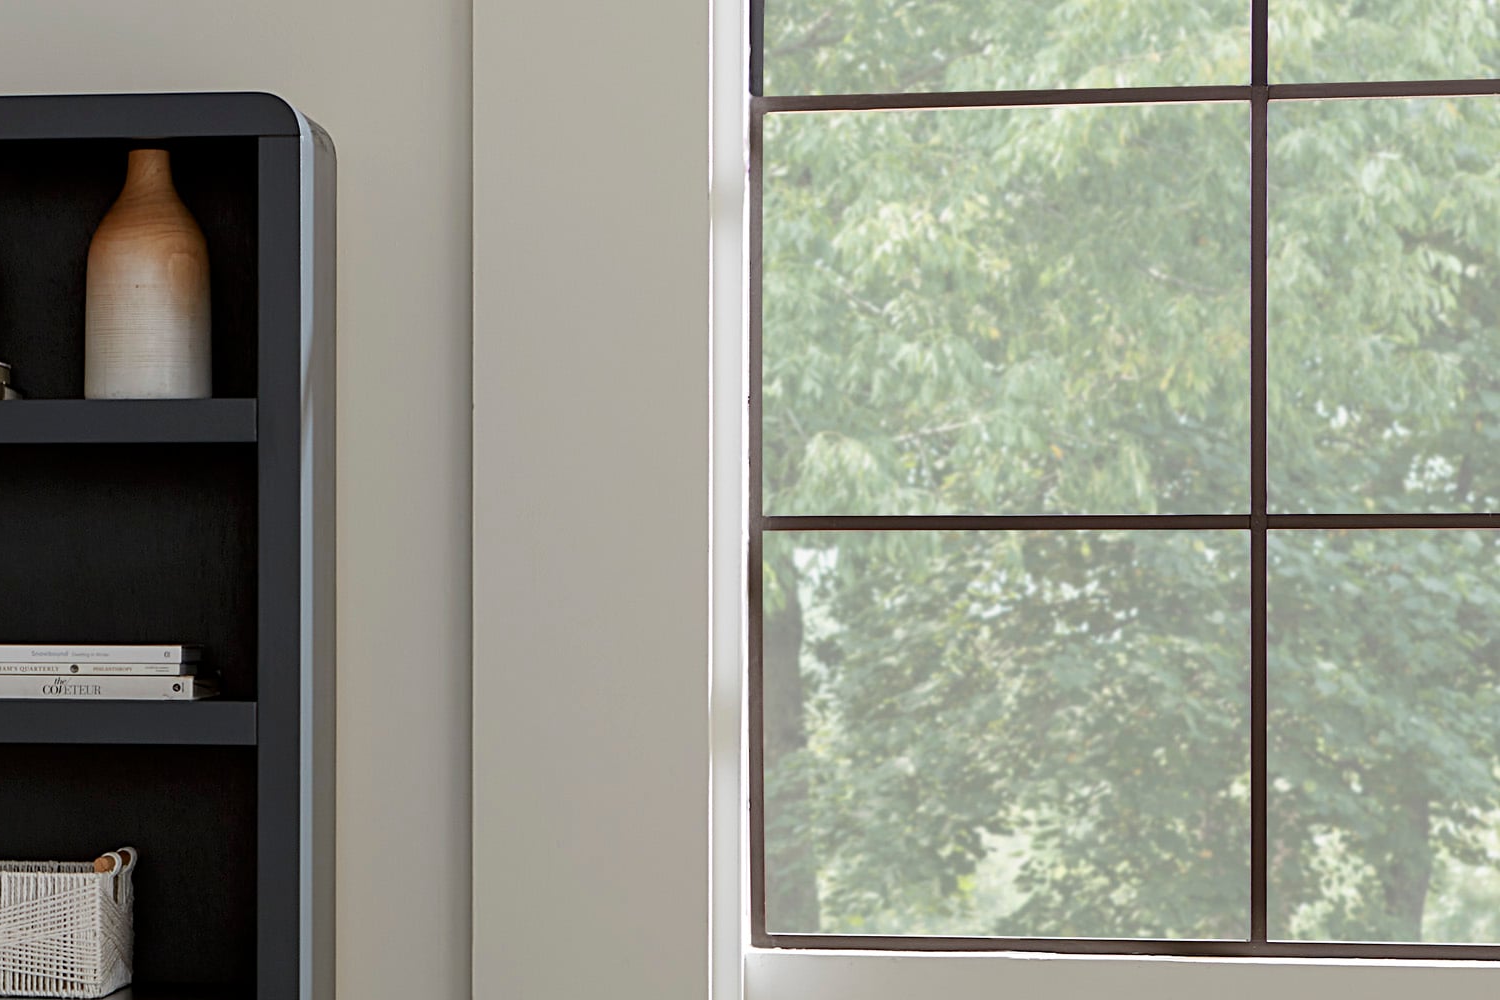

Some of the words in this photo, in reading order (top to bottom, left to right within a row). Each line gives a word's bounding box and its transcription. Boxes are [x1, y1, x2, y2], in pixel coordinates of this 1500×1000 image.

[19, 665, 59, 673] QUARTERLY
[54, 676, 67, 685] the
[42, 684, 101, 695] COVETEUR
